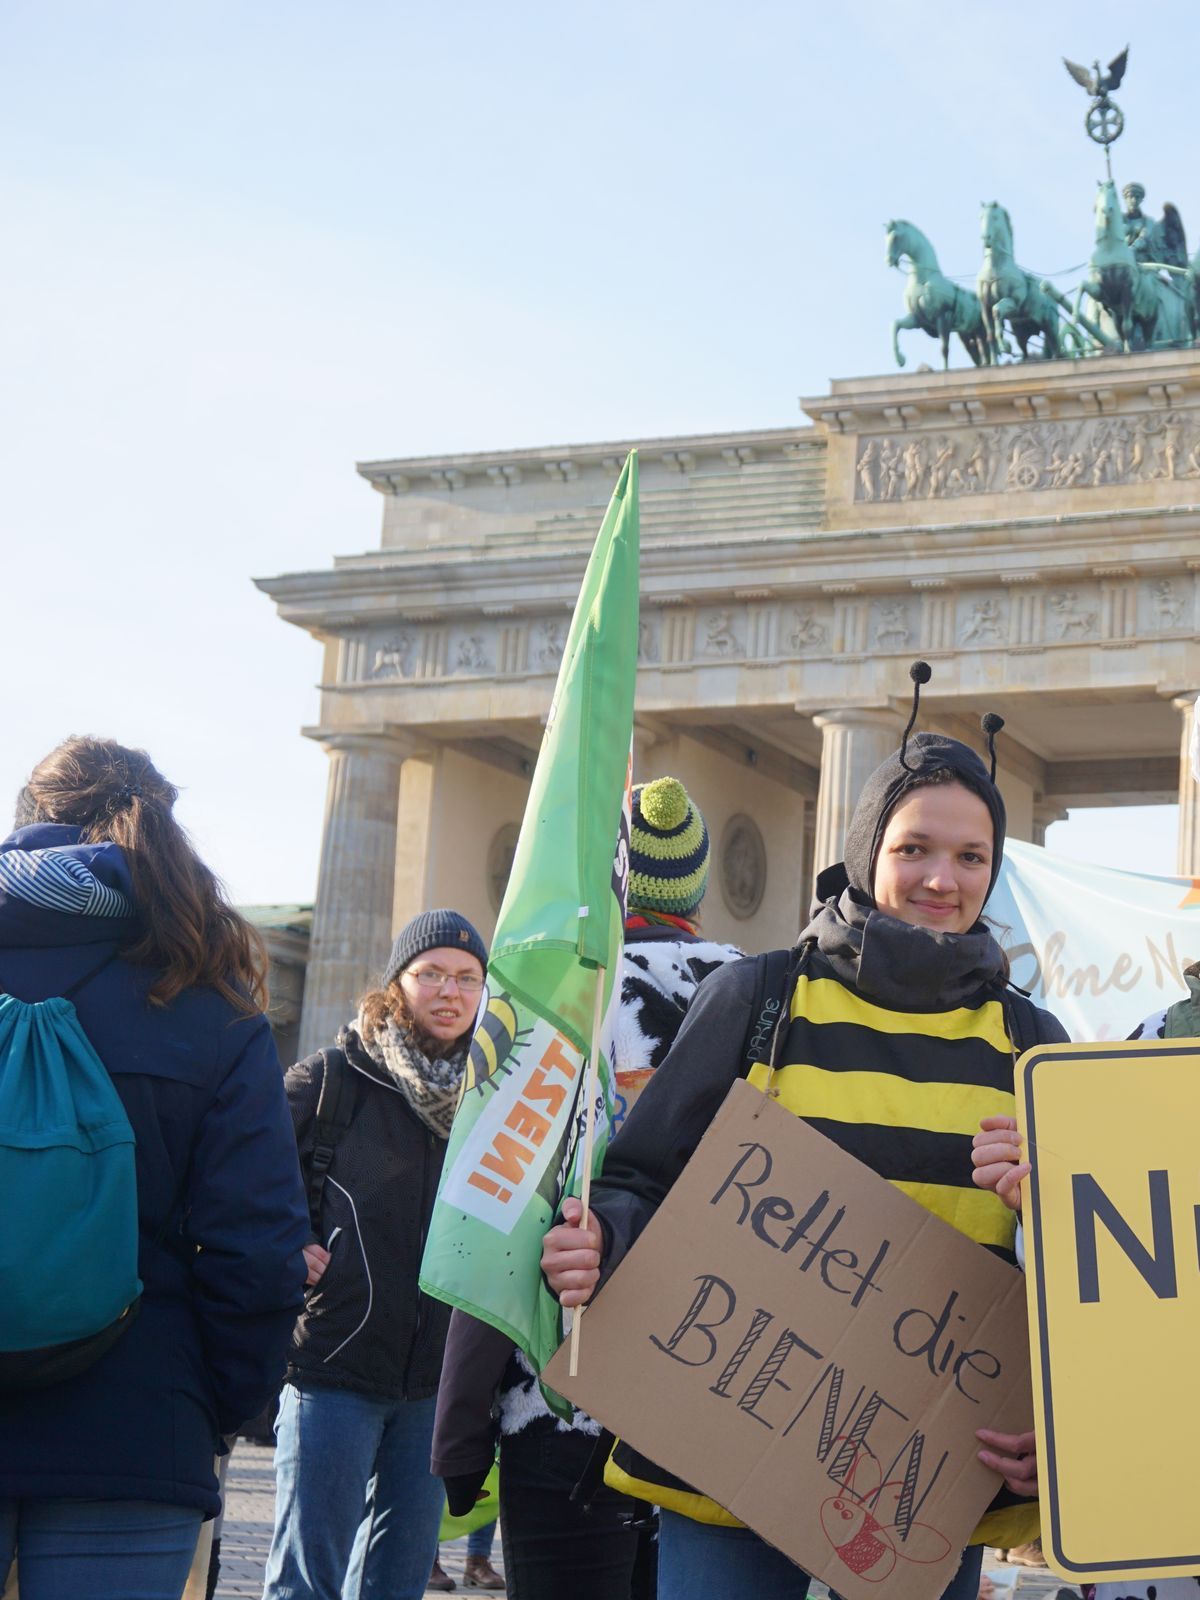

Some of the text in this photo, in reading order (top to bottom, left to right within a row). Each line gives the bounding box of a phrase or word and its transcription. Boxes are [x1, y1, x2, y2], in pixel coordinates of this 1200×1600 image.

[710, 1142, 1001, 1404] Rettet die
[649, 1274, 949, 1542] BIENEN
